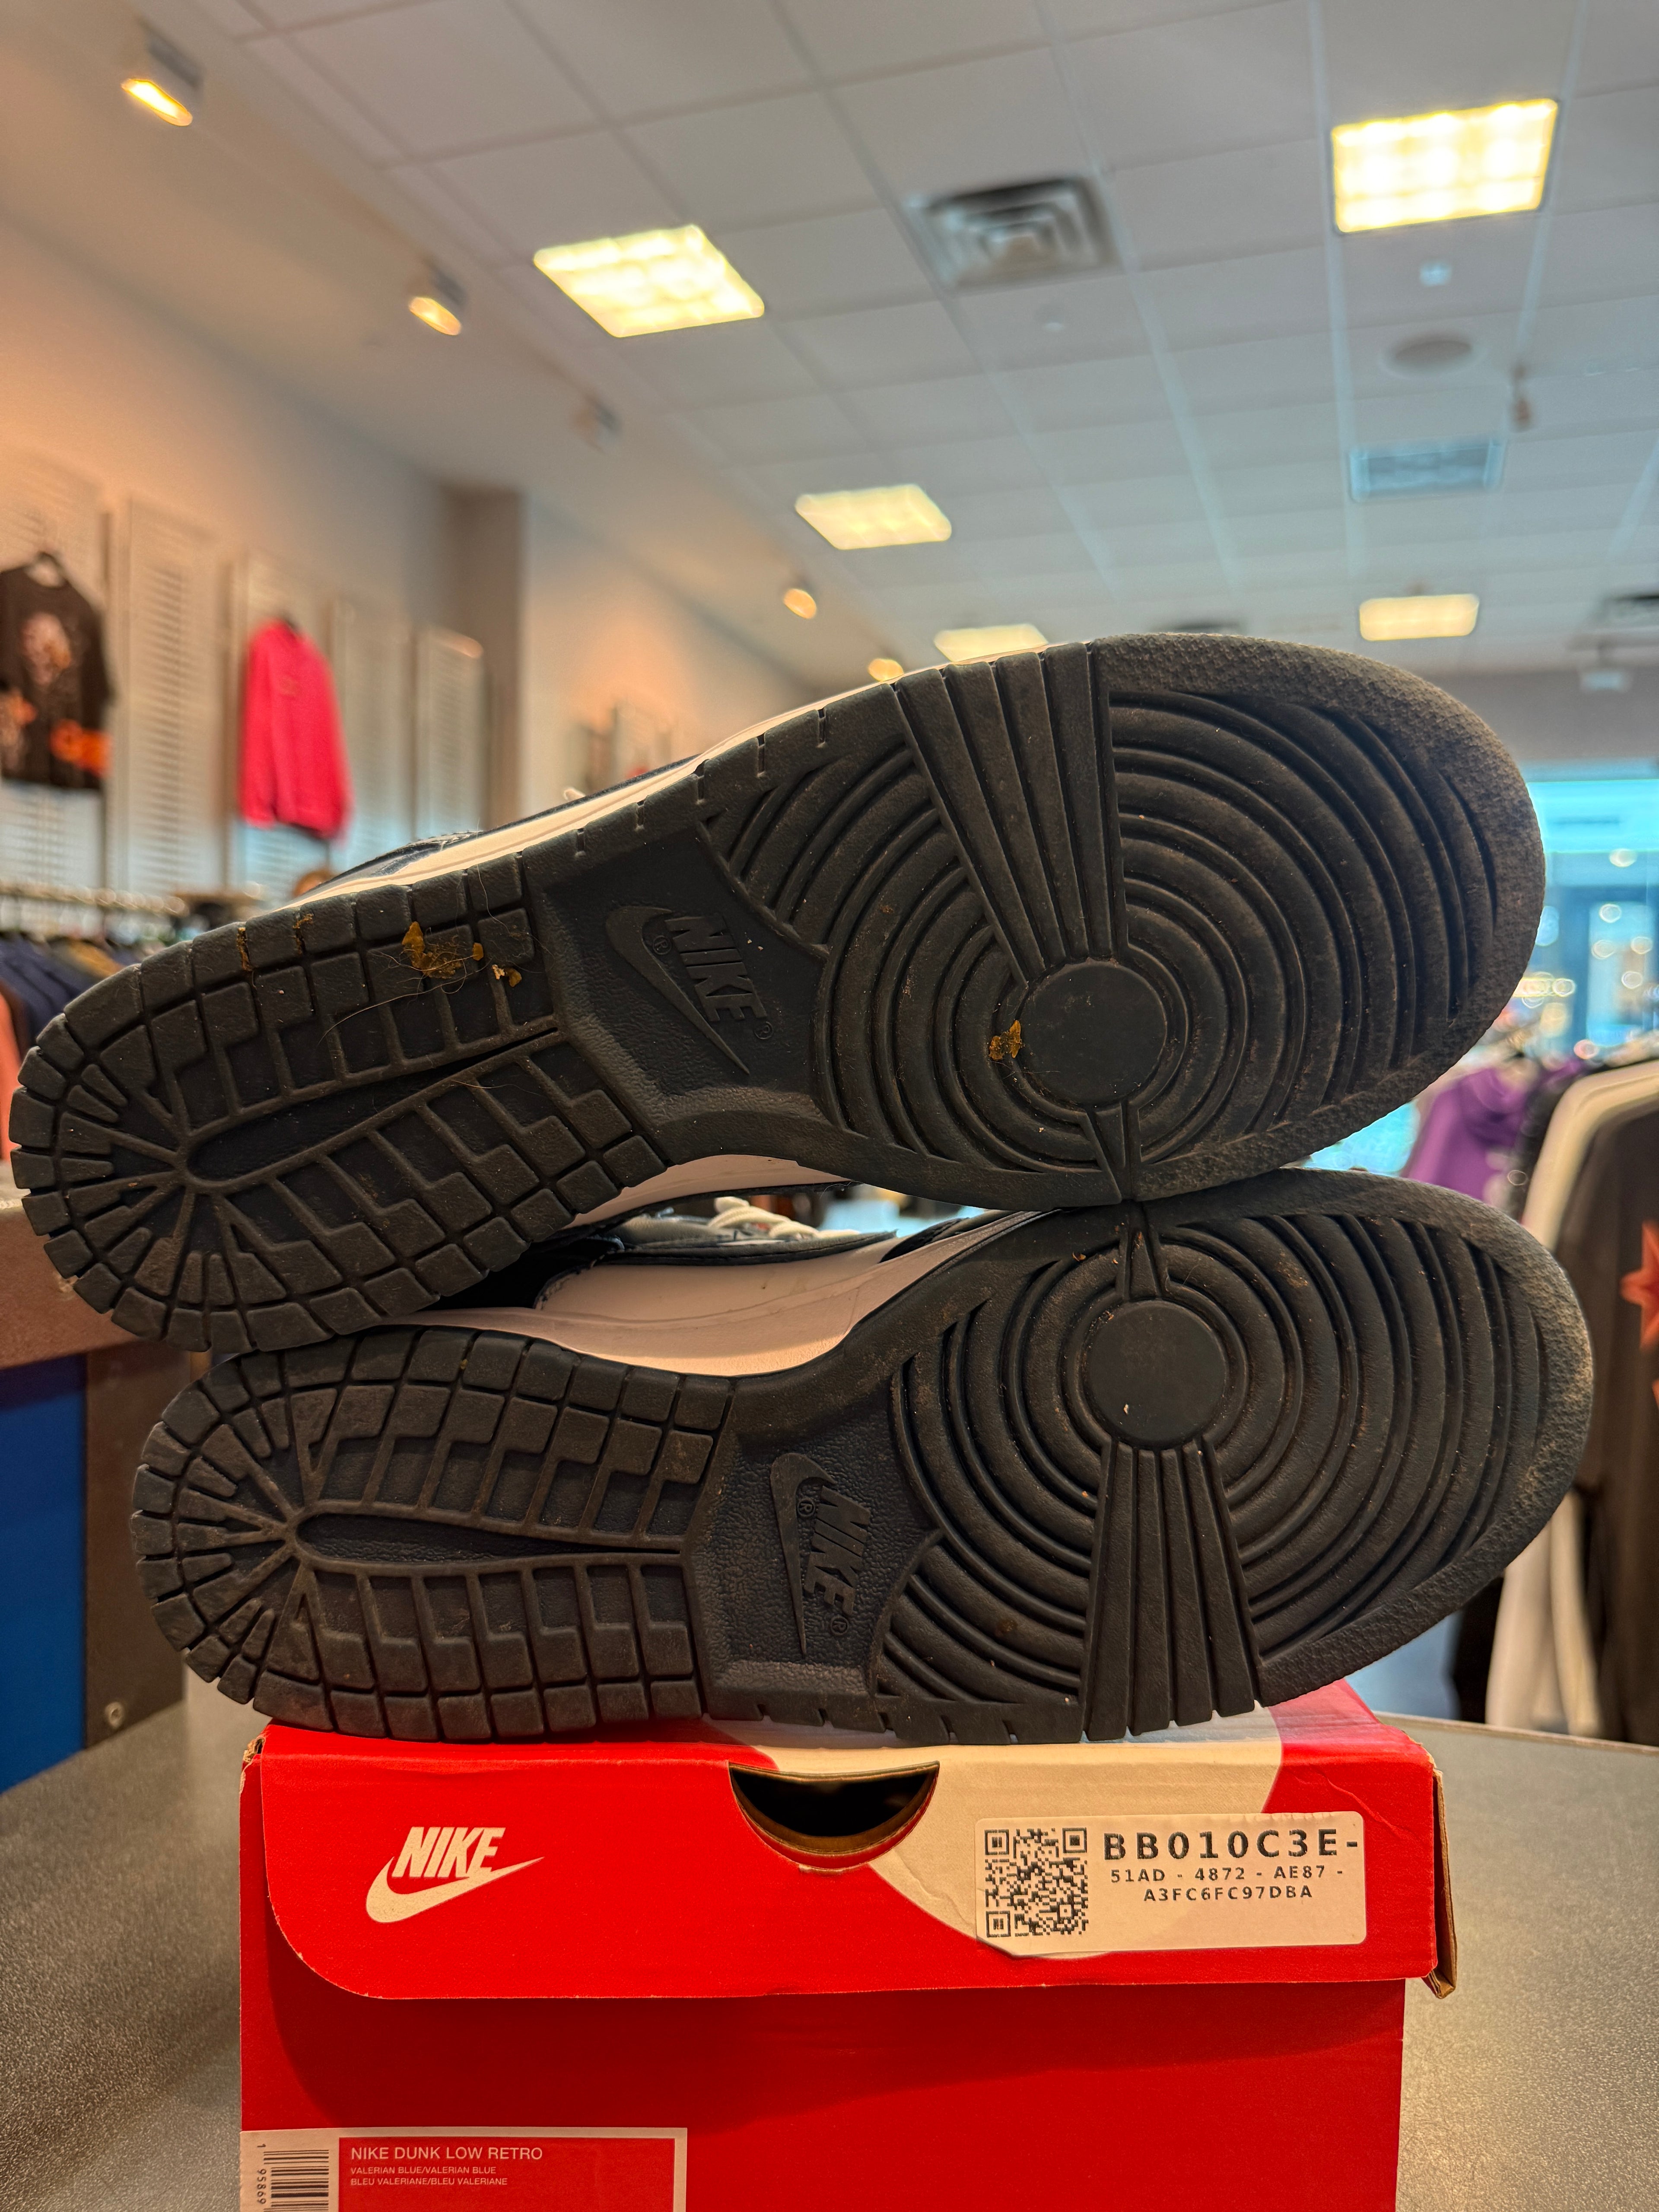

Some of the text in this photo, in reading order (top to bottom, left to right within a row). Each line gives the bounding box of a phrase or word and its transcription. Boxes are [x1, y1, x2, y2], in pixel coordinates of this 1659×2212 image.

[665, 916, 767, 1022] NIKE
[804, 1485, 871, 1616] NIKE
[391, 1826, 506, 1878] NIKE
[1104, 1829, 1357, 1860] BB010C3E-
[1144, 1885, 1312, 1901] A3FC6FC97DBA
[351, 2147, 543, 2160] NIKE DUNK LOW RETRO
[257, 2169, 267, 2204] 95869
